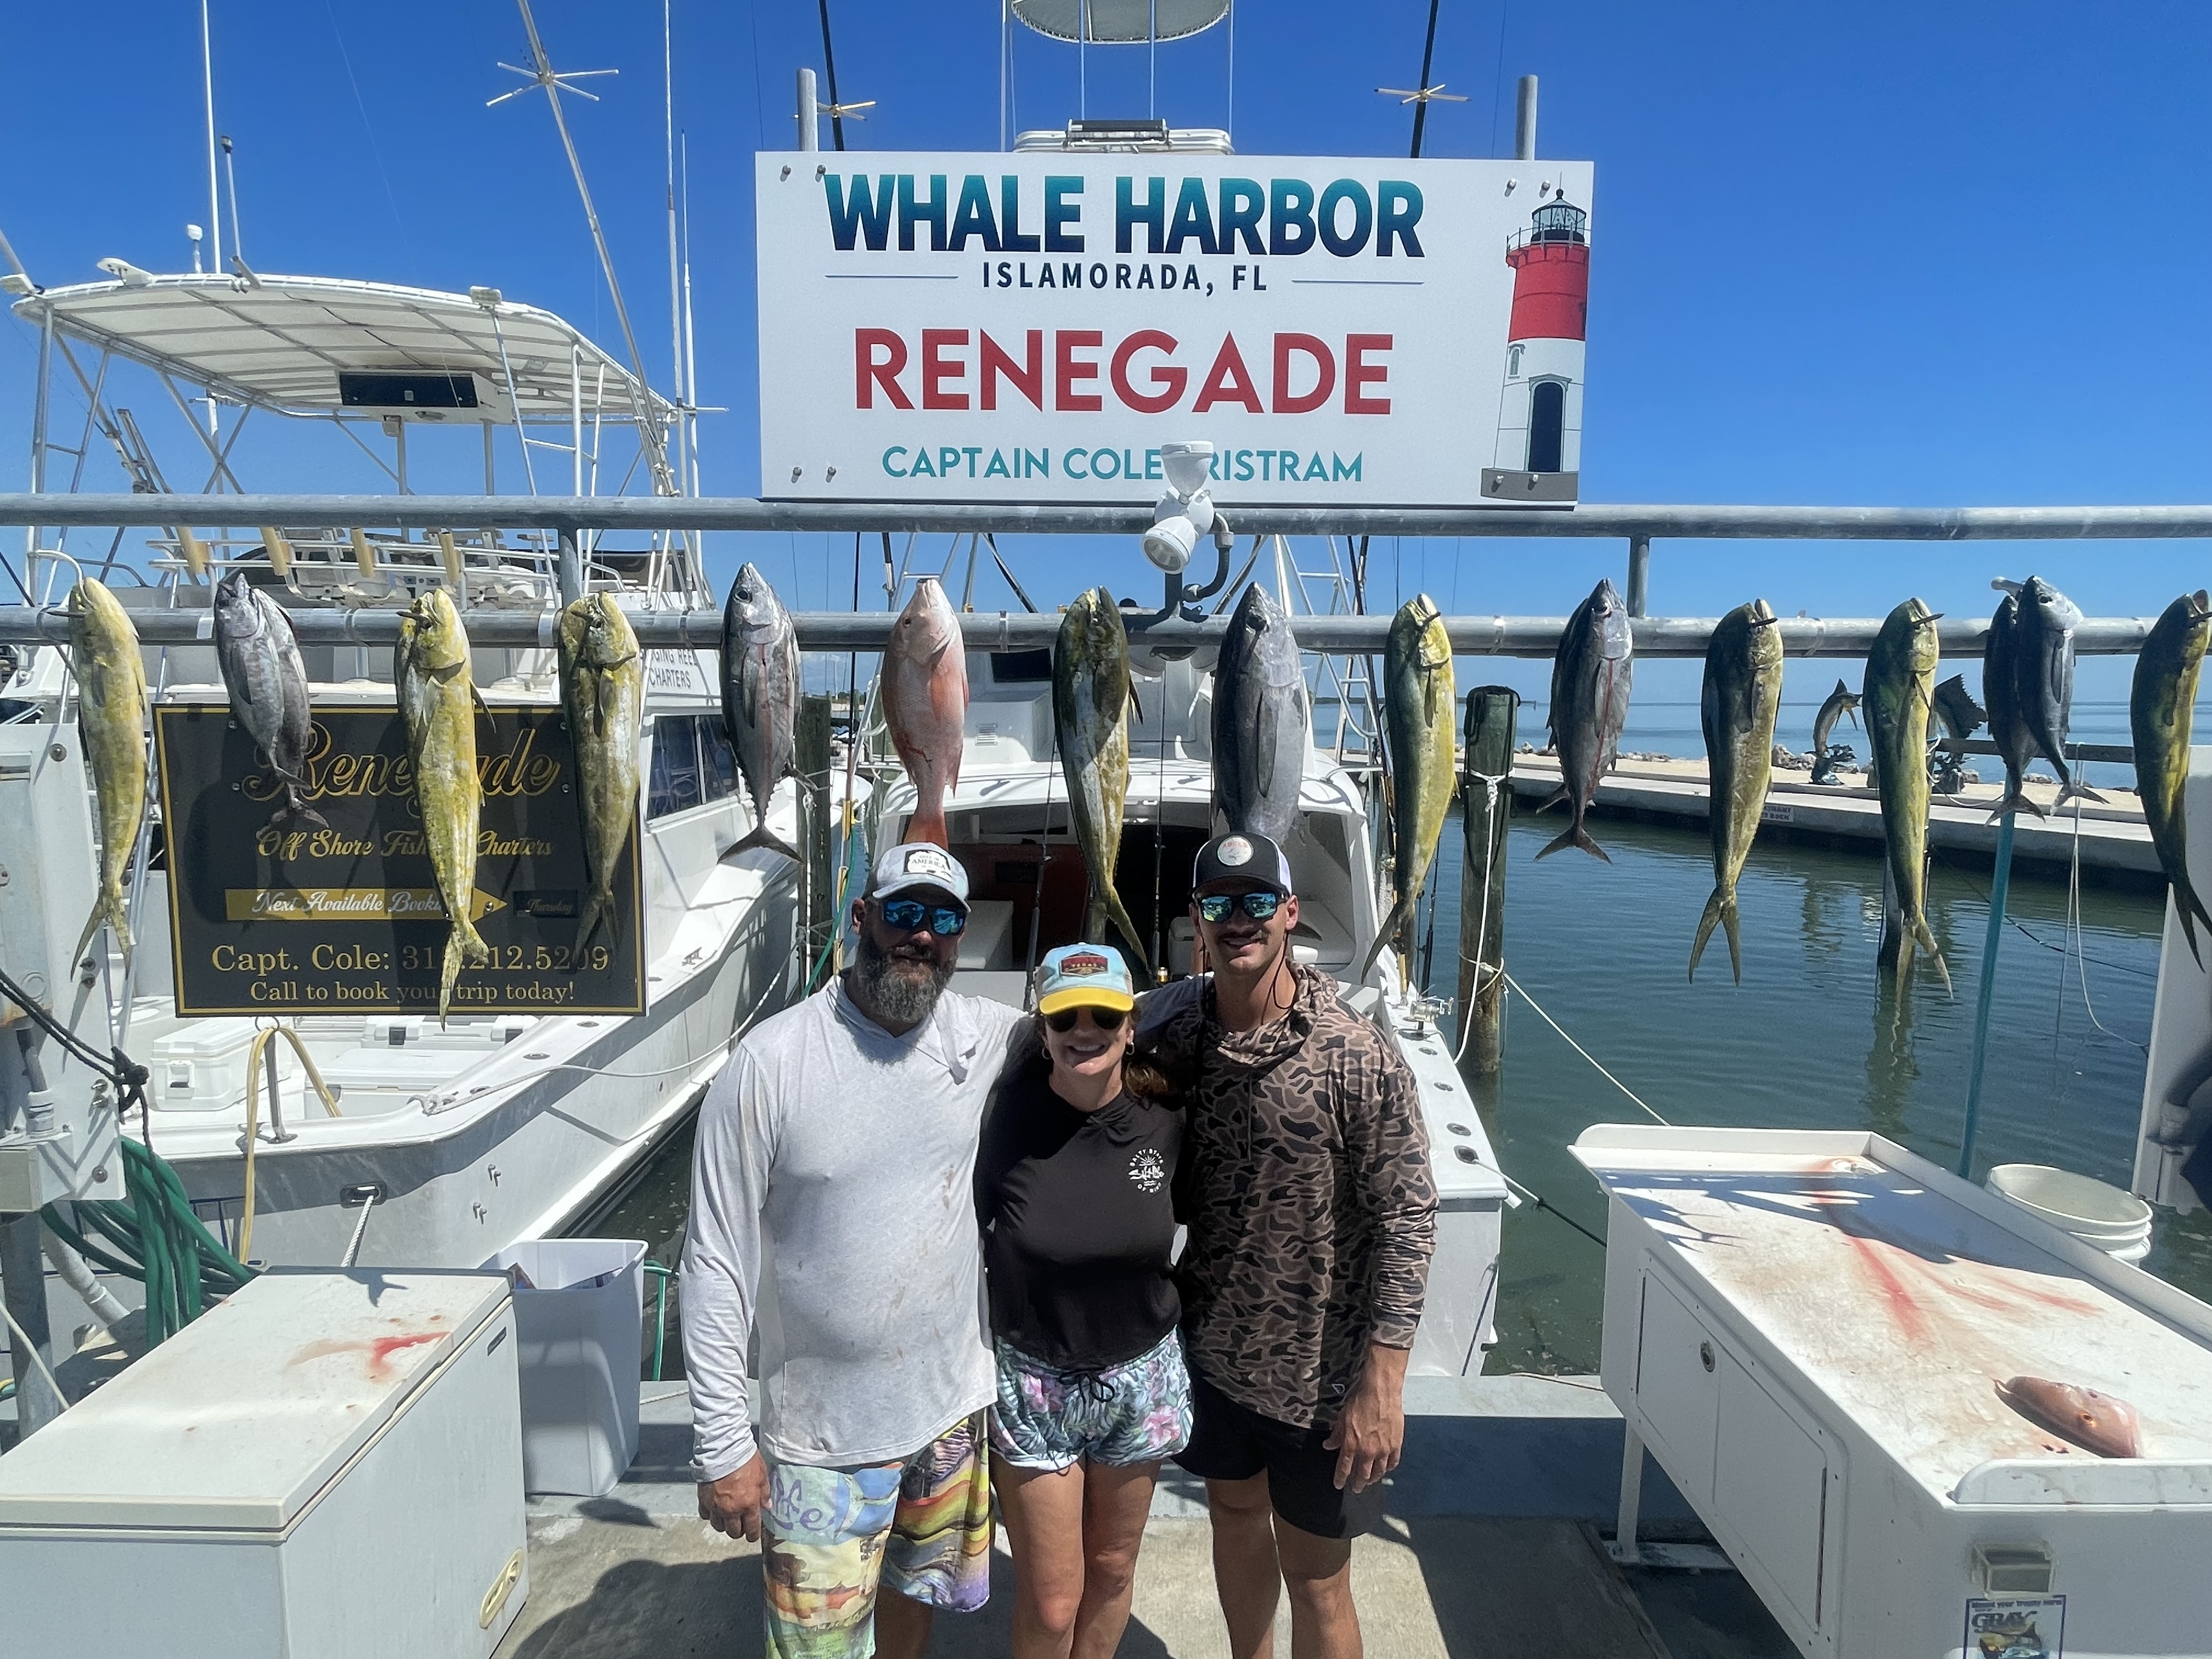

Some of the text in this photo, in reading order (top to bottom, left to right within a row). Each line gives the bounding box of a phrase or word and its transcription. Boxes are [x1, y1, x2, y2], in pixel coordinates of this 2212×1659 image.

[824, 174, 1425, 258] WHALE HARBOR
[984, 262, 1267, 297] ISLAMORADA, FL
[855, 328, 1393, 415] RENEGADE
[881, 445, 1363, 482] CAPTAIN COLE RISTRAM
[649, 667, 691, 688] CHARTERS
[242, 720, 561, 819] Renede
[258, 829, 553, 861] Off Shore Fish Charters
[911, 858, 946, 870] AMERICA
[251, 890, 301, 913] Next
[302, 890, 383, 912] Available
[211, 945, 299, 977] Capt.
[311, 943, 390, 970] Cole:
[250, 980, 574, 1005] Call to book you trip today!
